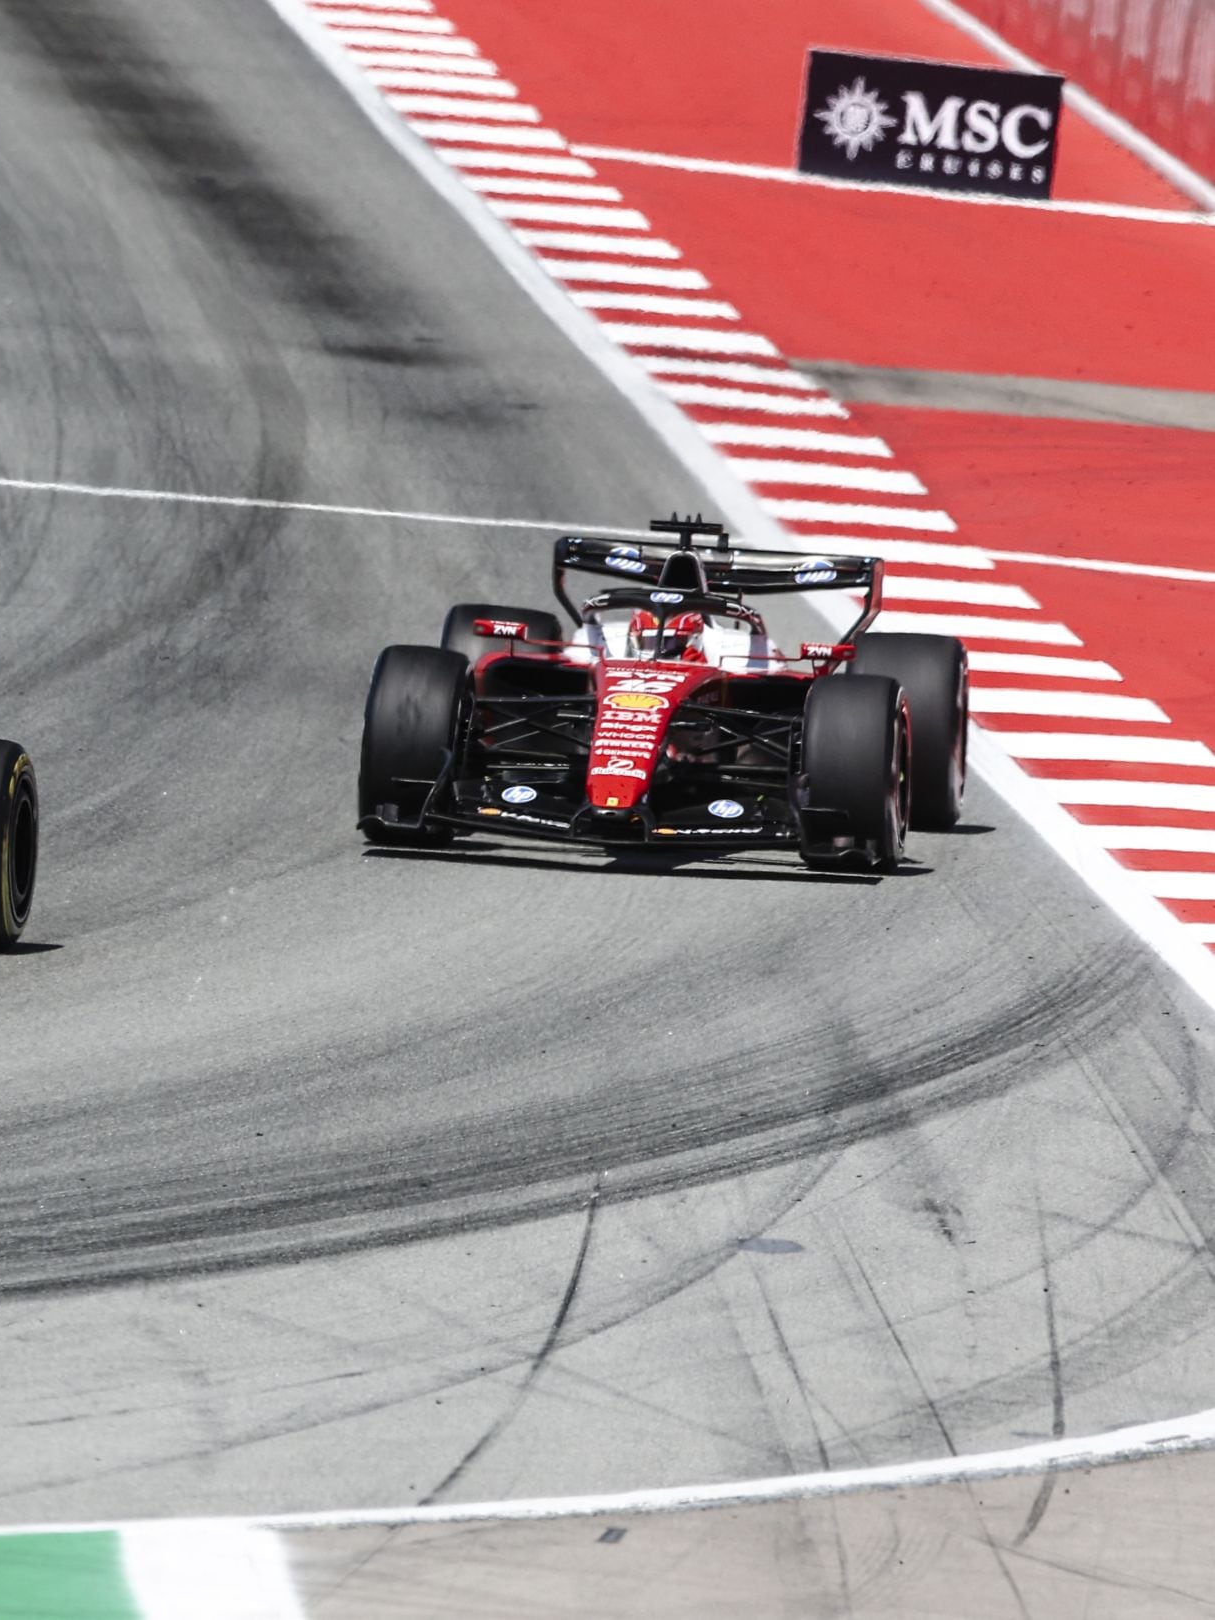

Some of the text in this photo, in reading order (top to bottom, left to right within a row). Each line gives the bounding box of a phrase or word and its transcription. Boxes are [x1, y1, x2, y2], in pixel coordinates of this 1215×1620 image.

[897, 90, 1052, 159] MSC
[895, 149, 1046, 185] CRUISES
[493, 625, 517, 636] ZYN
[807, 646, 832, 657] ZYN
[607, 679, 678, 694] 16
[601, 711, 663, 724] IBM
[501, 786, 538, 804] hp
[707, 799, 744, 819] hp
